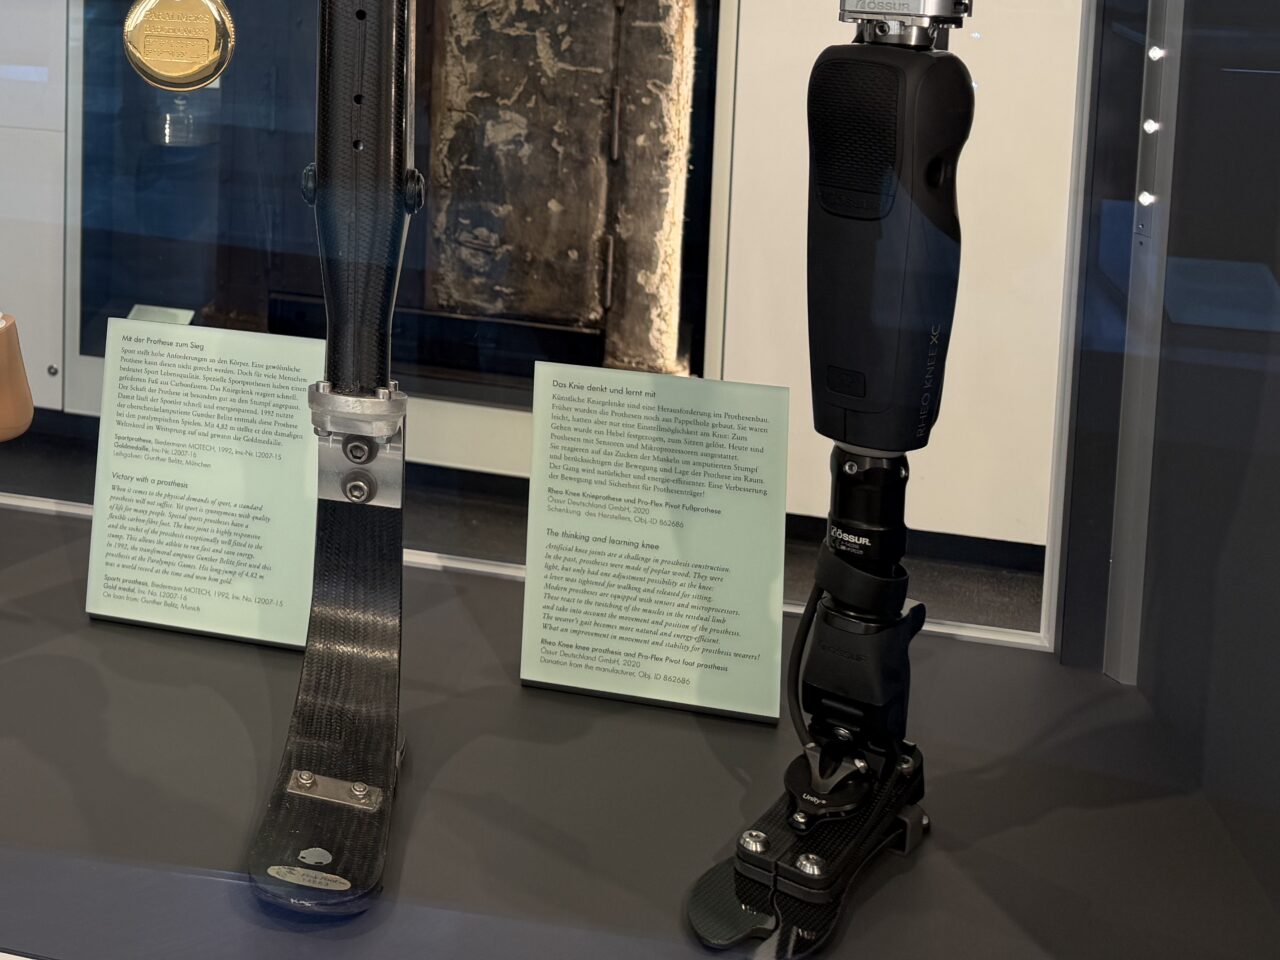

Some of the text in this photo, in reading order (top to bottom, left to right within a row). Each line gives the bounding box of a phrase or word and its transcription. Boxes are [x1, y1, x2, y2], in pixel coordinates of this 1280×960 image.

[121, 334, 133, 342] Mit
[133, 336, 145, 344] der
[146, 337, 174, 346] Prothese
[190, 341, 205, 351] Sieg
[552, 380, 567, 389] Das
[568, 381, 585, 390] Knie
[586, 383, 608, 393] denkt
[609, 387, 624, 395] und
[625, 387, 643, 397] lernt
[916, 323, 941, 437] RHEO KNEE XC
[552, 394, 586, 404] Künstliche
[586, 397, 626, 408] Kniegelenke
[642, 404, 657, 412] eine
[656, 405, 712, 419] Herausforderung
[713, 411, 722, 419] im
[550, 433, 582, 443] Prothesen
[595, 438, 625, 448] Sensoren
[625, 442, 639, 450] und
[640, 443, 698, 456] Mikroprozessoren
[112, 472, 135, 483] Victory
[156, 480, 188, 488] prosthesis
[548, 462, 561, 470] Der
[562, 464, 580, 474] Gang
[596, 469, 632, 479] natürlicher
[647, 476, 706, 488] energie-effizienter.
[708, 481, 724, 490] Eine
[724, 483, 768, 496] Verbesserung
[548, 472, 559, 480] der
[560, 474, 593, 486] Bewegung
[608, 479, 640, 490] Sicherheit
[641, 483, 651, 491] für
[653, 485, 705, 498] Prothesenträger!
[547, 487, 564, 496] Rheo
[564, 489, 581, 498] Knee
[582, 491, 622, 503] Knieprothese
[637, 498, 663, 508] Pro-Flex
[664, 501, 681, 510] Pivot
[682, 503, 722, 515] Fußprothese
[567, 498, 607, 510] Deutschland
[633, 506, 650, 515] 2020
[585, 509, 597, 518] des
[659, 518, 684, 528] 862686
[547, 528, 660, 550] The thinking and learning knee
[544, 583, 568, 592] Modern
[568, 588, 598, 597] prostheses
[610, 594, 638, 603] equipped
[690, 604, 742, 616] microprocessors.
[542, 623, 560, 632] What
[569, 627, 610, 639] improvement
[618, 636, 650, 645] movement
[651, 639, 664, 647] and
[665, 641, 690, 652] stability
[691, 644, 701, 653] for
[700, 647, 732, 656] prosthesis
[733, 652, 760, 661] wearers!
[540, 638, 728, 672] Rheo Knee knee prosthesis and Pro-Flex Pivot foot prosthesis
[559, 650, 597, 662] Deutschland
[622, 659, 641, 668] 2020
[540, 656, 568, 667] Donation
[569, 660, 583, 669] from
[584, 663, 594, 671] the
[654, 673, 662, 681] ID
[662, 674, 691, 685] 862686
